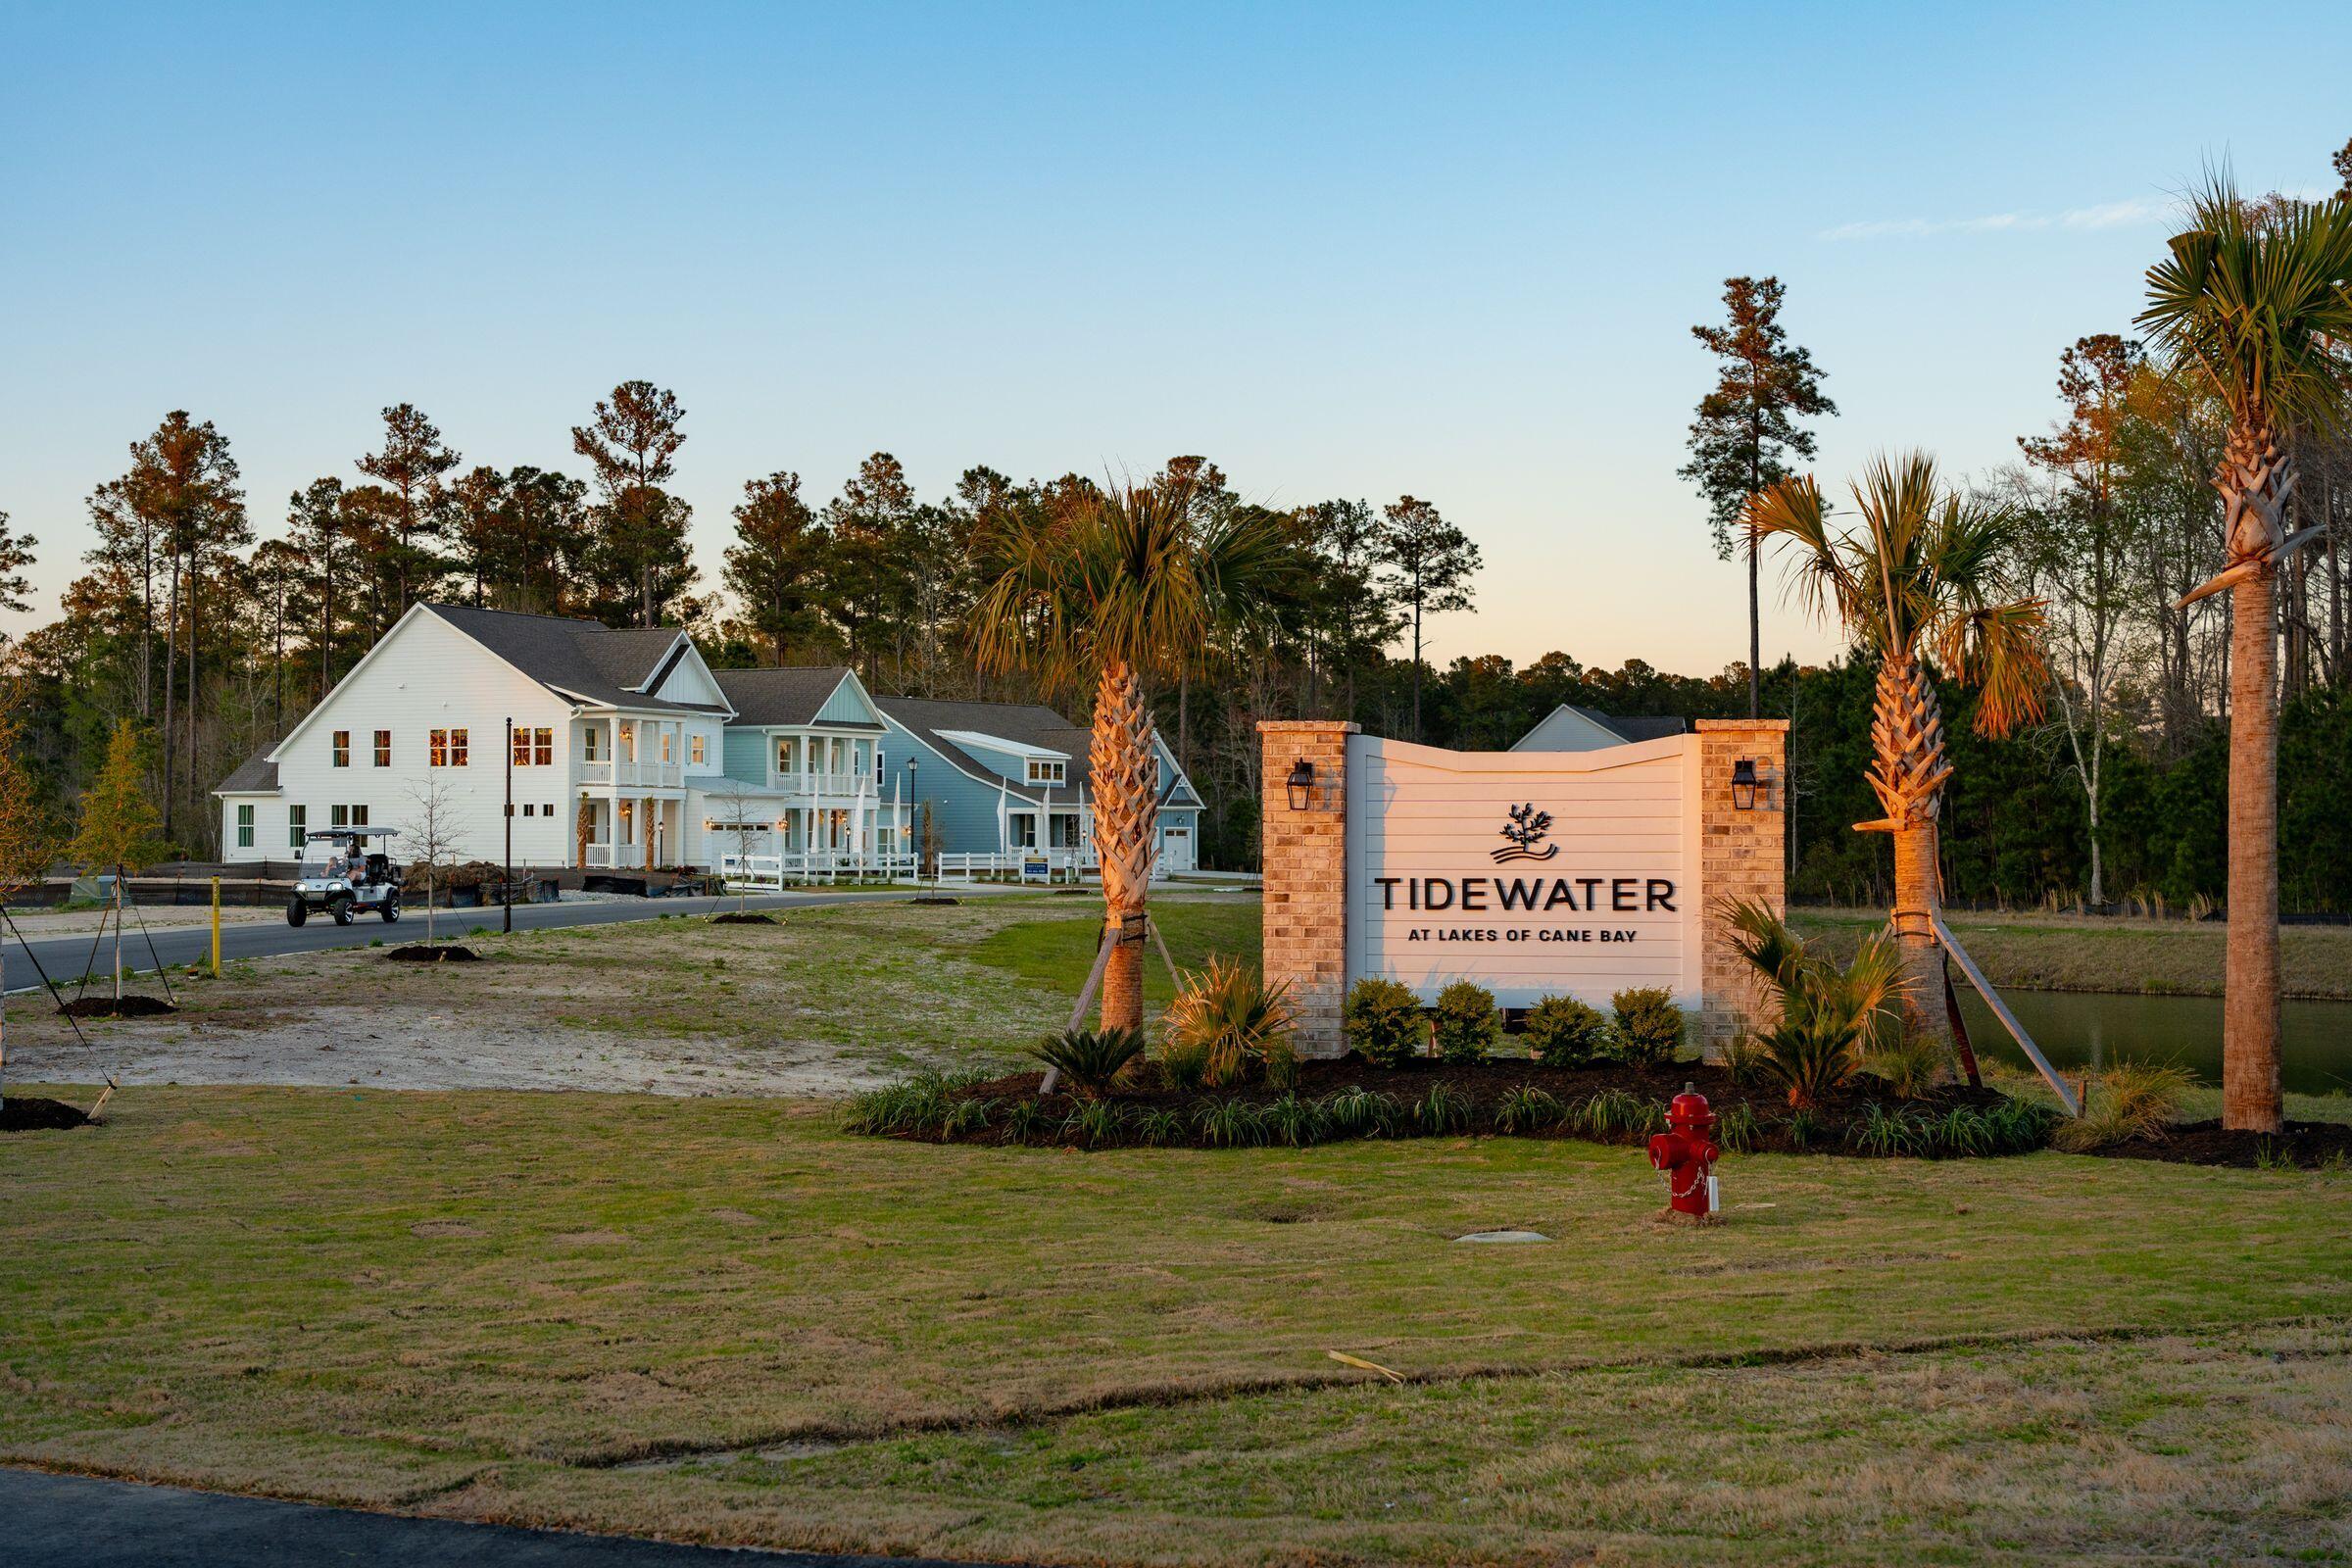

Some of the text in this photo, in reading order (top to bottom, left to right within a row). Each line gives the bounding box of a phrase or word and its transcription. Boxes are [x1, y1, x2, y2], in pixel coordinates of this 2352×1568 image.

[1374, 877, 1677, 912] TIDEWATER
[1408, 929, 1638, 943] AT LAKES OF CANE BAY
